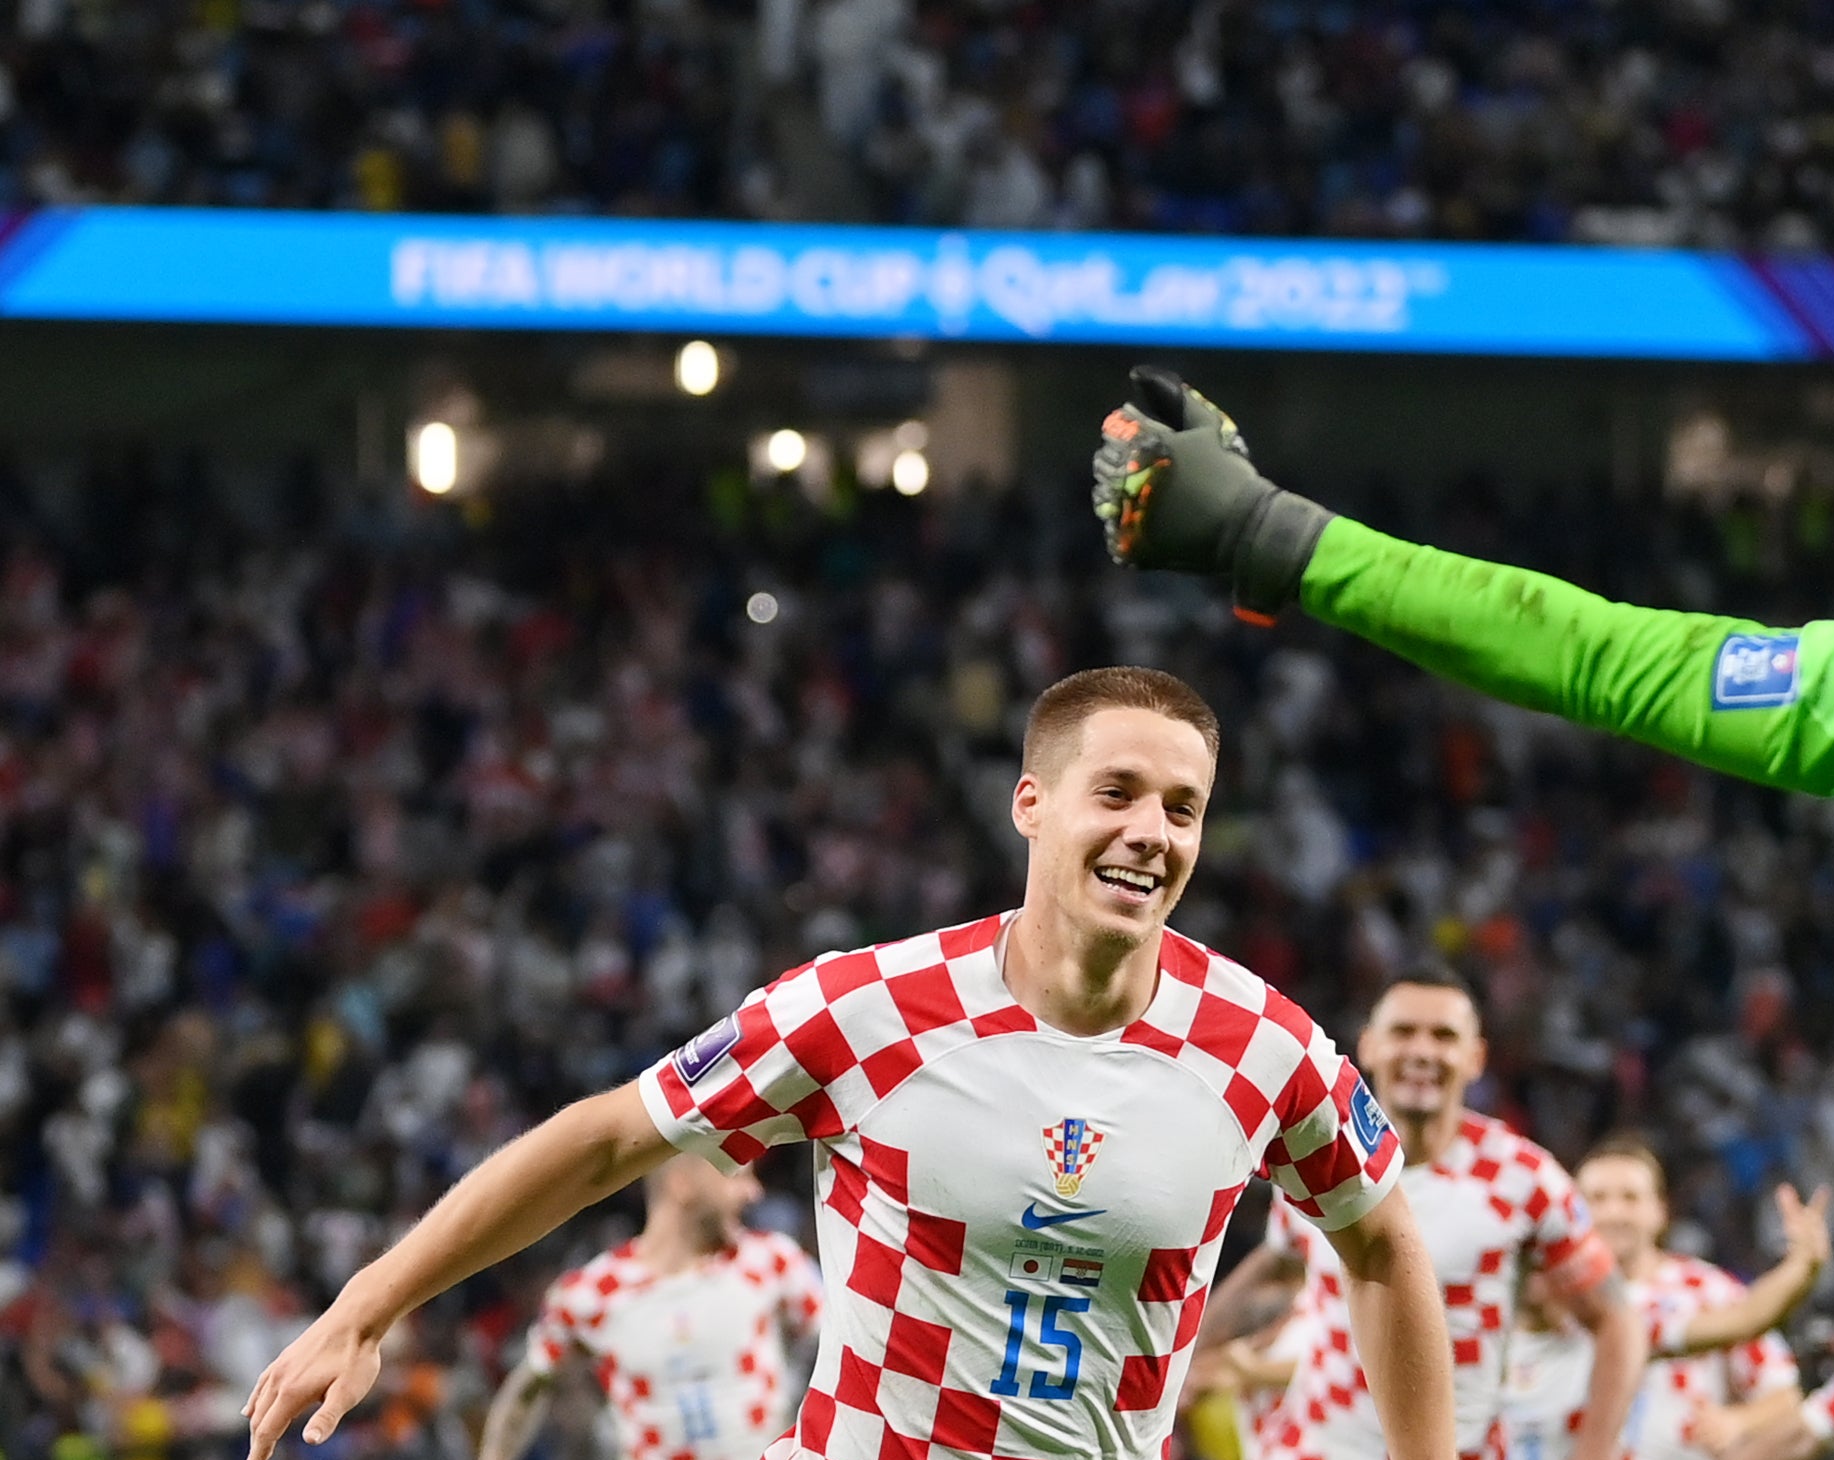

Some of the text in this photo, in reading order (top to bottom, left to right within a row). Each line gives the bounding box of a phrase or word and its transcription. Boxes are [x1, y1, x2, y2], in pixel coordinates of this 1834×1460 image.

[392, 236, 542, 308] FIFA
[546, 241, 786, 315] WORLD
[792, 247, 922, 318] CUP
[989, 1289, 1091, 1400] 15
